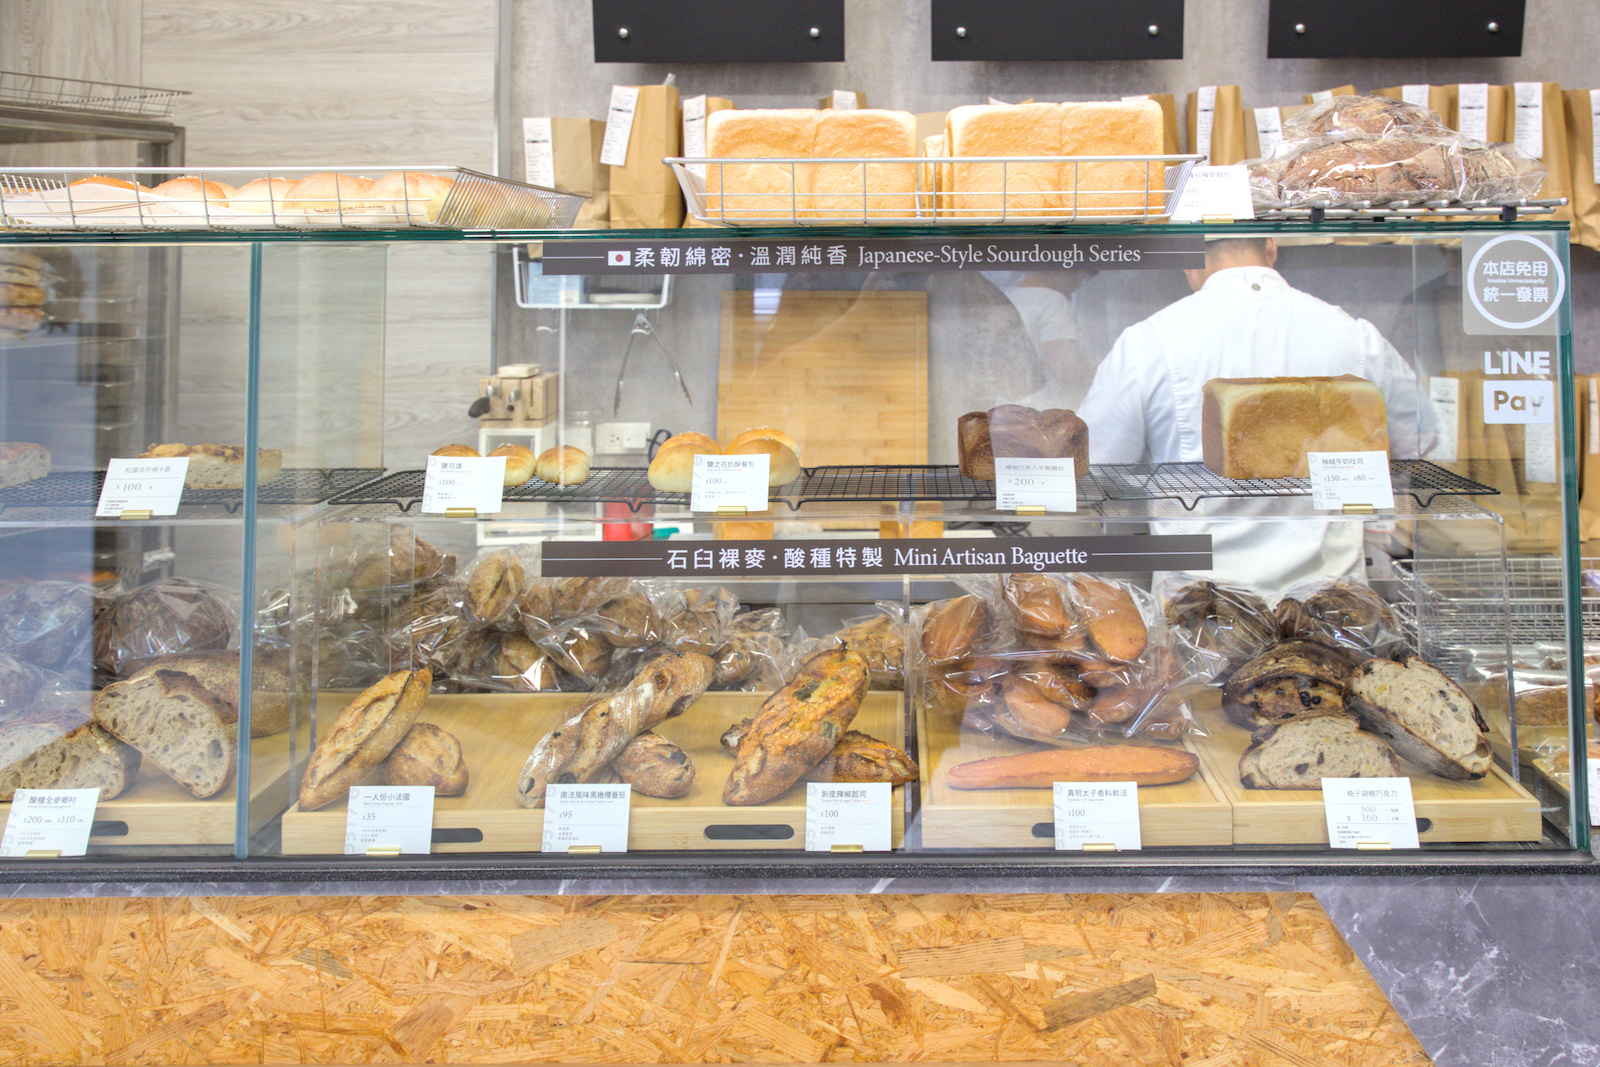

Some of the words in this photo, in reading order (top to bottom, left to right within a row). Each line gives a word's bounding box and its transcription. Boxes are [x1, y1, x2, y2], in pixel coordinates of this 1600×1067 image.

[634, 244, 848, 268] 柔韌綿密·溫潤純香
[858, 245, 983, 269] Japanese-Style
[986, 243, 1085, 269] Sourdough
[1089, 244, 1141, 263] Series
[1482, 260, 1549, 277] 本店免用
[1483, 286, 1549, 303] 統一發票
[1484, 351, 1551, 375] LINE
[1493, 390, 1545, 417] Pay
[666, 547, 884, 570] 石臼裸麥·酸種特製
[894, 548, 939, 566] Mini
[940, 548, 1007, 566] Artisan
[1011, 546, 1088, 571] Baguette
[363, 793, 410, 801] 一人份小法國
[362, 813, 376, 821] $35
